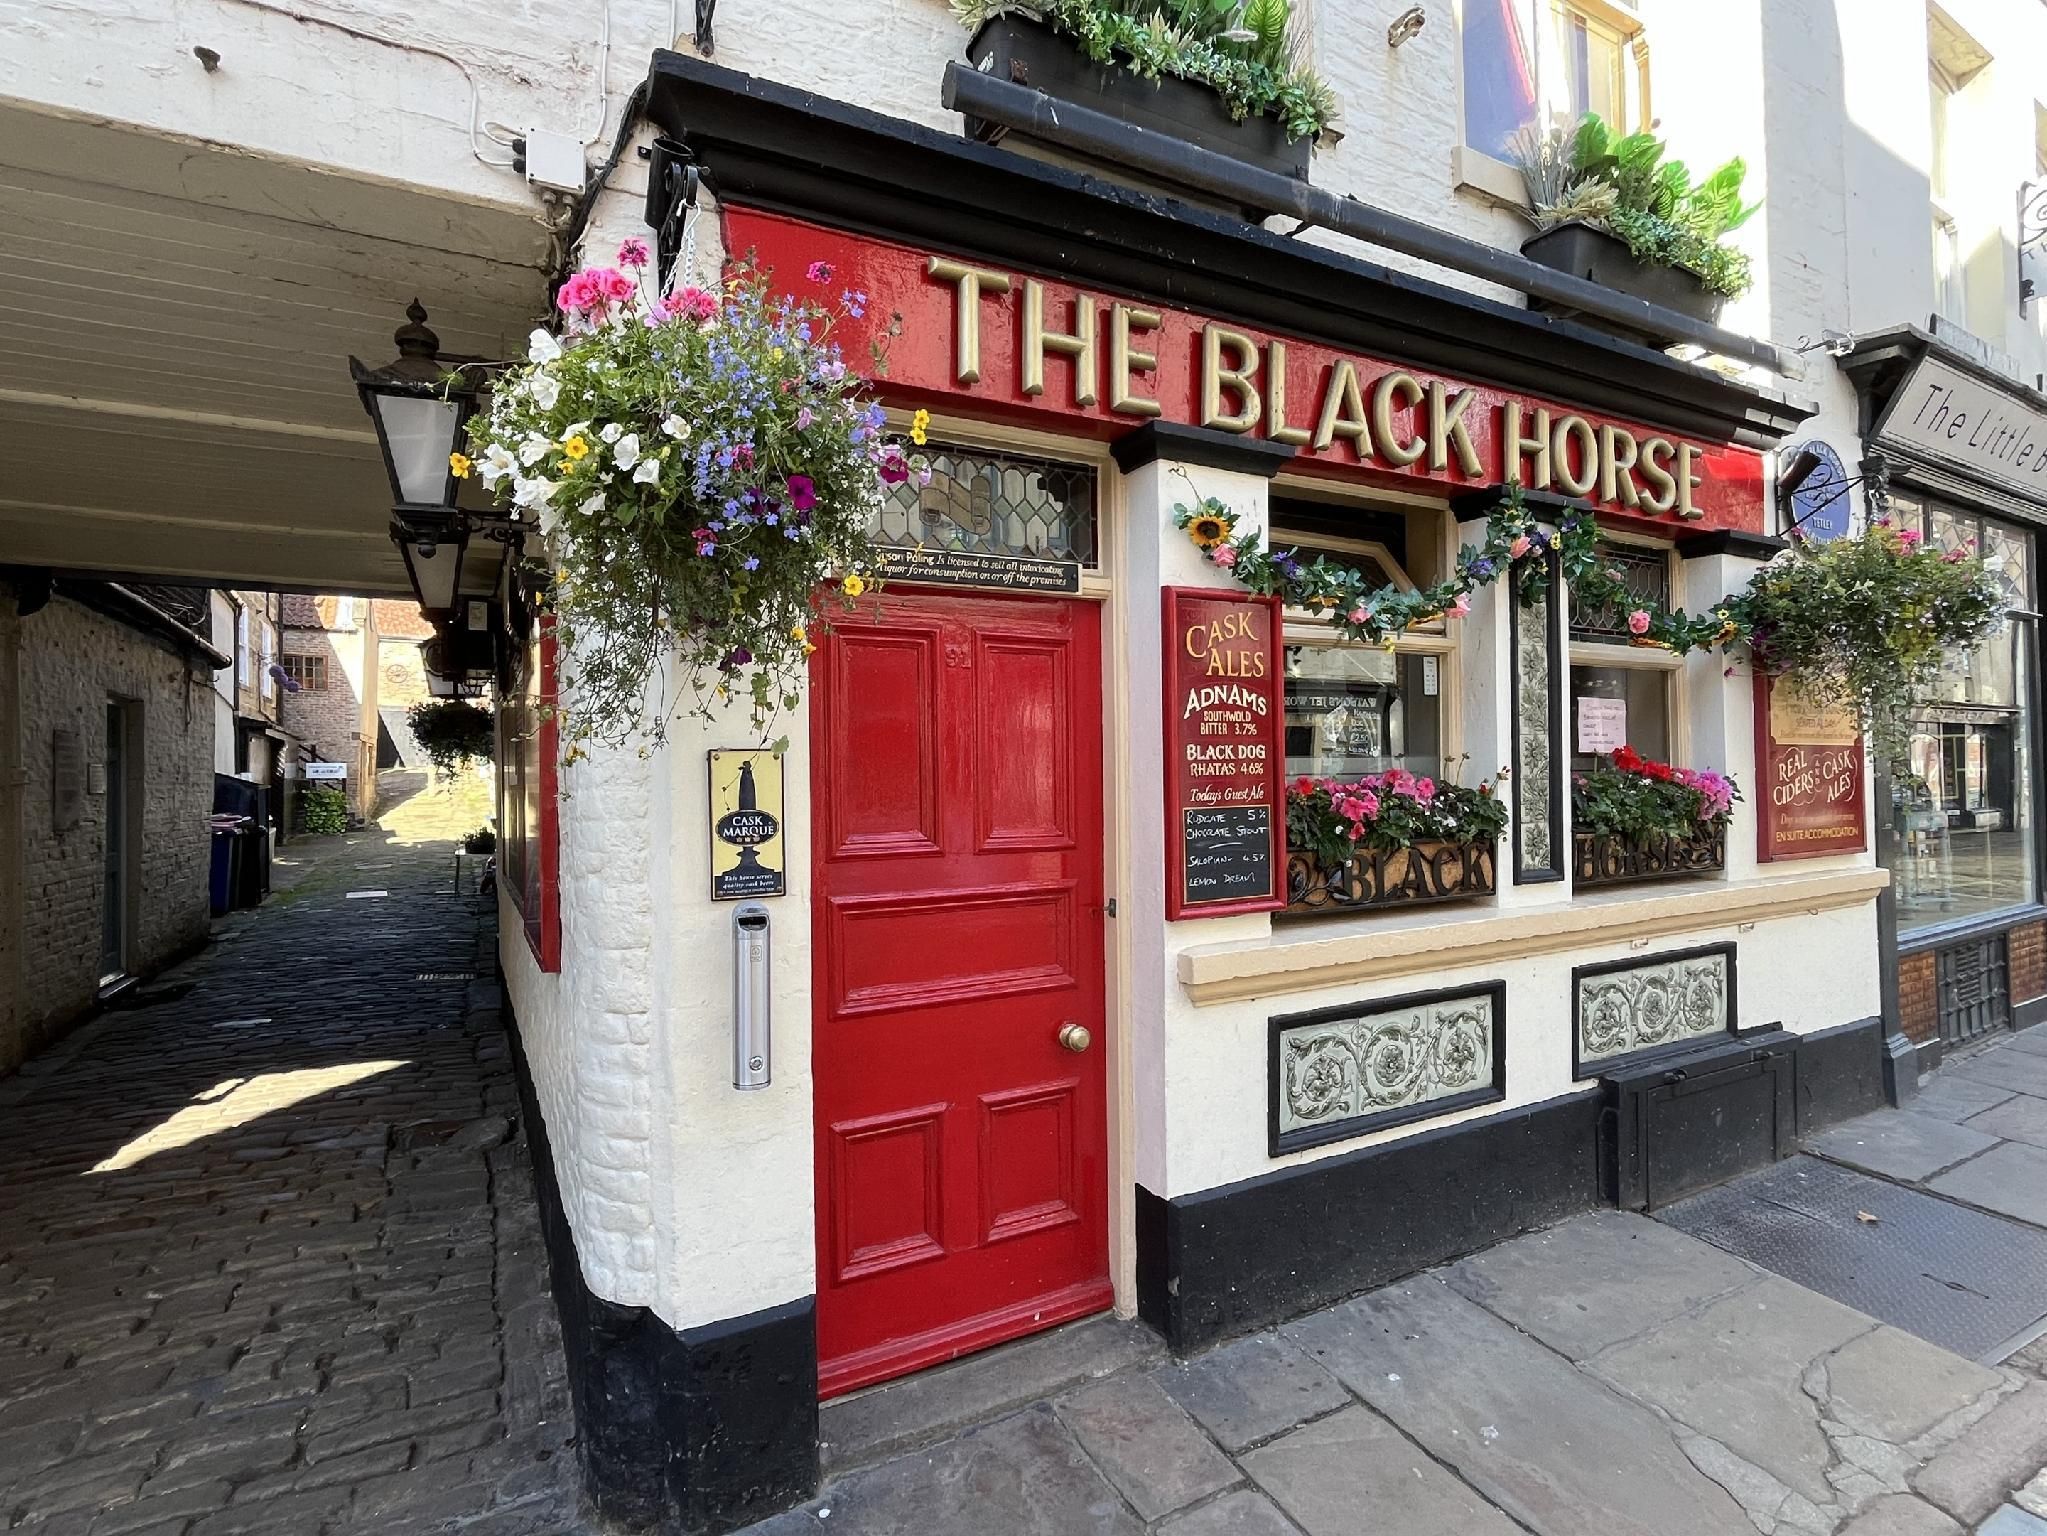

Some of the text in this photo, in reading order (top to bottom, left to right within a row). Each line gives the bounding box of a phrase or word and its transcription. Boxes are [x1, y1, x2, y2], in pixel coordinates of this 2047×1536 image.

[927, 255, 1705, 520] THE BLACK HORSE
[1912, 384, 1966, 439] The
[1968, 408, 2034, 466] Little
[906, 563, 925, 576] for
[924, 568, 978, 580] consumption
[1002, 571, 1016, 585] off
[1016, 572, 1030, 583] the
[1030, 577, 1067, 587] premises
[947, 556, 979, 567] licensed
[982, 559, 989, 568] to
[990, 561, 1004, 570] sell
[1006, 561, 1018, 570] all
[1020, 563, 1065, 577] intoxicating
[1186, 611, 1259, 658] CASK
[1206, 647, 1264, 678] ALES
[1183, 684, 1267, 720] ADNAMS
[1203, 710, 1252, 722] SOUTHWOLD
[1200, 722, 1257, 735] BITTER 3.7%
[1186, 744, 1266, 760] BLACK DOG
[1190, 762, 1236, 777] RHATAS
[1779, 751, 1807, 781] REAL
[1823, 750, 1854, 779] CASK
[1224, 787, 1249, 800] Guest
[1246, 782, 1265, 803] Ale
[1773, 770, 1851, 806] CIDERS ALES
[732, 815, 763, 826] CASK
[1236, 825, 1268, 837] STOUT
[723, 825, 774, 838] MARQUE
[1188, 871, 1255, 887] LEMON DREAM
[1343, 843, 1495, 903] BLACK
